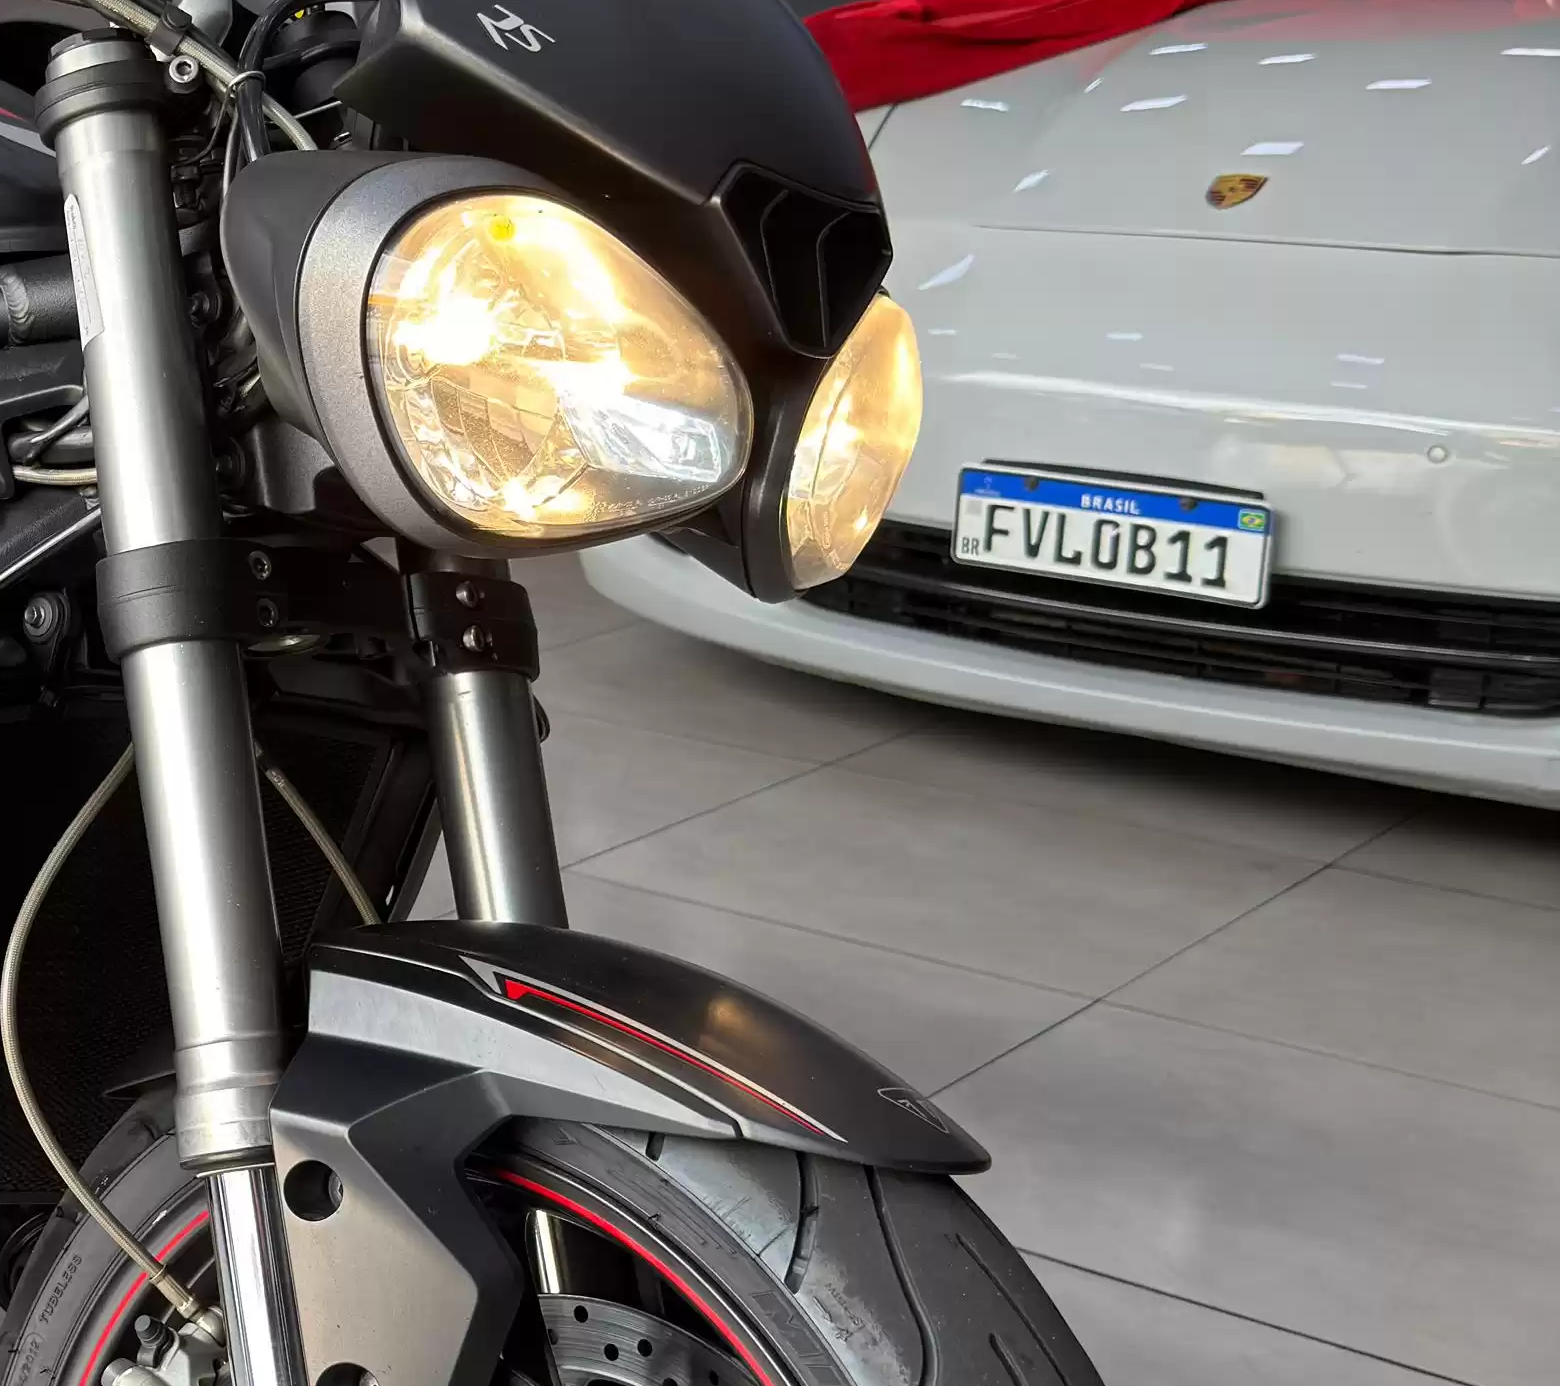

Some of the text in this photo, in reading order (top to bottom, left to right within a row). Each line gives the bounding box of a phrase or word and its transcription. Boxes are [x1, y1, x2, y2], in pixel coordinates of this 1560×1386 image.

[476, 4, 556, 53] RS
[1080, 493, 1141, 515] BRASIL
[961, 536, 980, 556] BR
